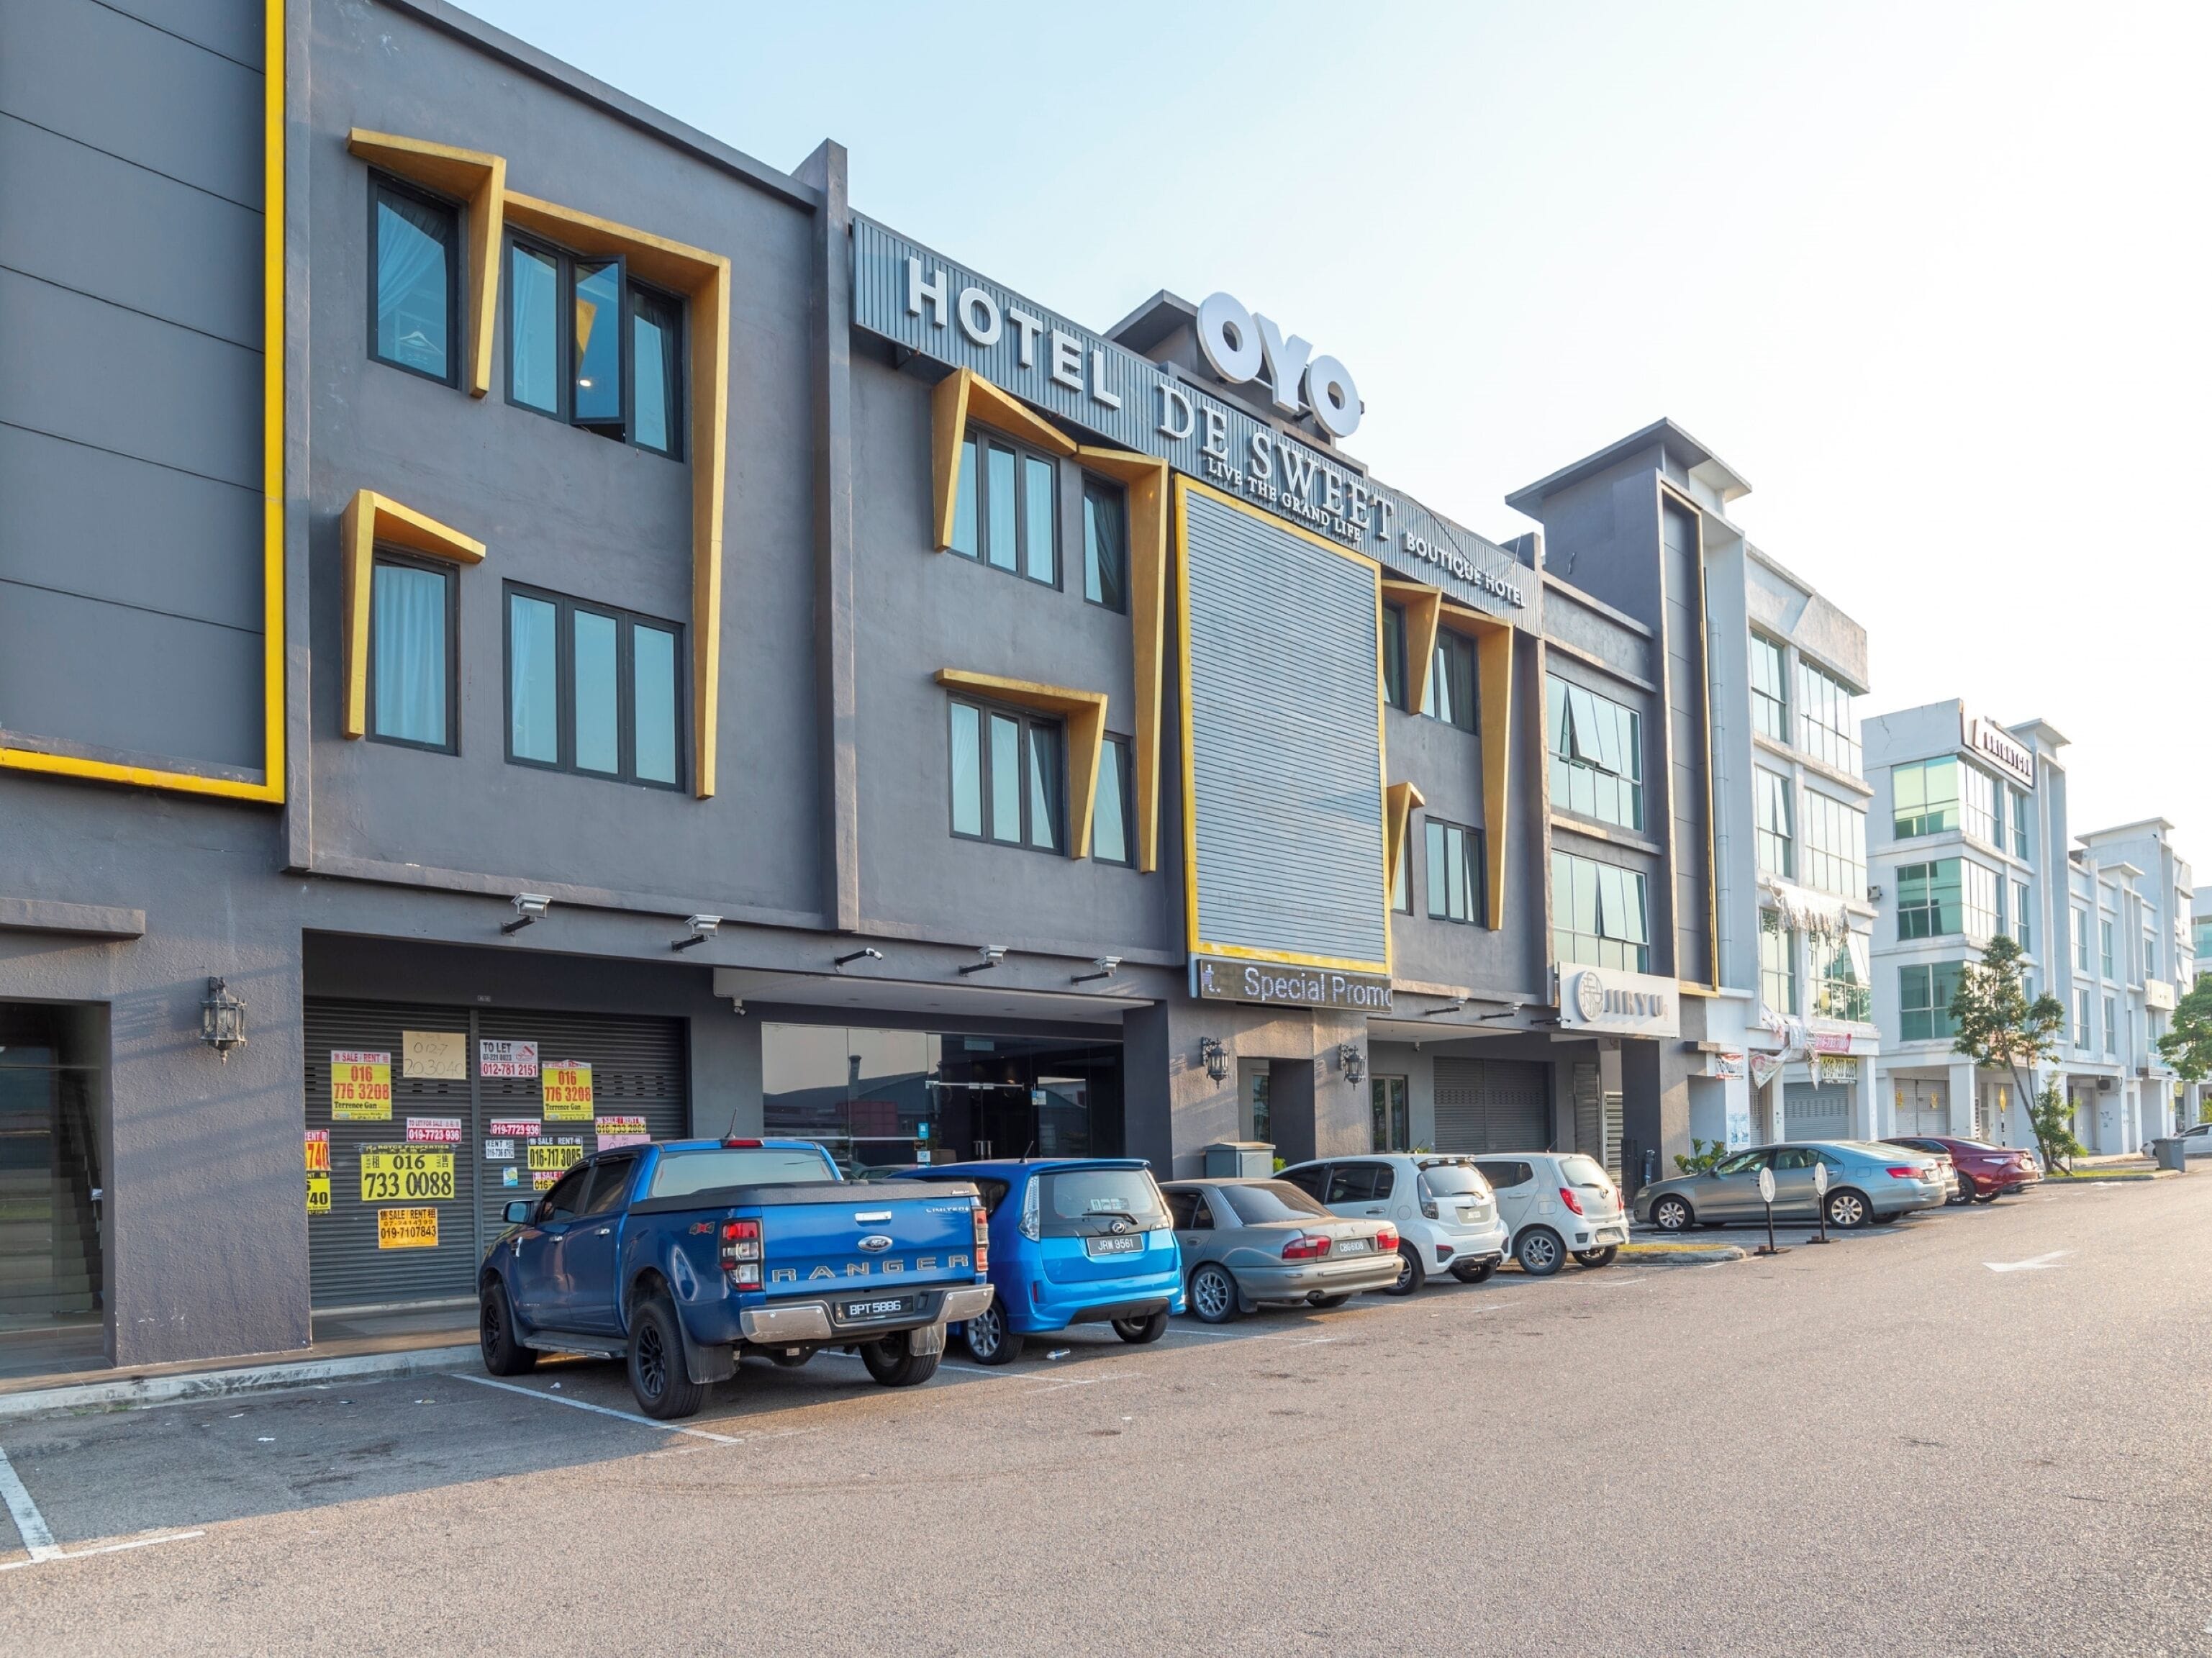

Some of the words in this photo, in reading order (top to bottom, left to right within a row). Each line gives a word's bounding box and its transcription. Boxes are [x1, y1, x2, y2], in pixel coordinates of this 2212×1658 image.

[1197, 292, 1361, 438] OYO
[906, 256, 1121, 410] HOTEL
[1158, 383, 1228, 461] DE
[1249, 432, 1394, 540] SWEET
[1207, 457, 1243, 486] LIVE
[1248, 476, 1277, 502] THE
[1281, 492, 1331, 526] GRAND
[1334, 517, 1361, 541] LIFE
[1405, 532, 1482, 586] BOUTIQUE
[1485, 572, 1526, 608] HOTEL
[1244, 966, 1325, 1001] Special
[483, 1042, 494, 1052] TO
[497, 1043, 512, 1053] LET
[342, 1053, 358, 1061] SALE
[363, 1054, 380, 1062] RENT
[350, 1065, 373, 1082] 016
[484, 1063, 515, 1075] 012-781
[518, 1064, 537, 1076] 2151
[558, 1070, 576, 1085] 016
[333, 1082, 354, 1100] 776
[358, 1083, 389, 1100] 3208
[545, 1087, 562, 1102] 776
[565, 1087, 591, 1102] 3208
[305, 1131, 321, 1141] ENT
[409, 1129, 444, 1141] 019-7723
[445, 1129, 460, 1141] 936
[492, 1124, 525, 1135] 019-7723
[526, 1124, 540, 1135] 936
[392, 1154, 425, 1169] 016
[530, 1149, 559, 1167] 016-717
[364, 1172, 399, 1198] 733
[406, 1172, 452, 1196] 0088
[307, 1192, 328, 1205] 40
[389, 1210, 405, 1220] SALE
[410, 1209, 427, 1219] RENT
[771, 1254, 969, 1283] RANGER
